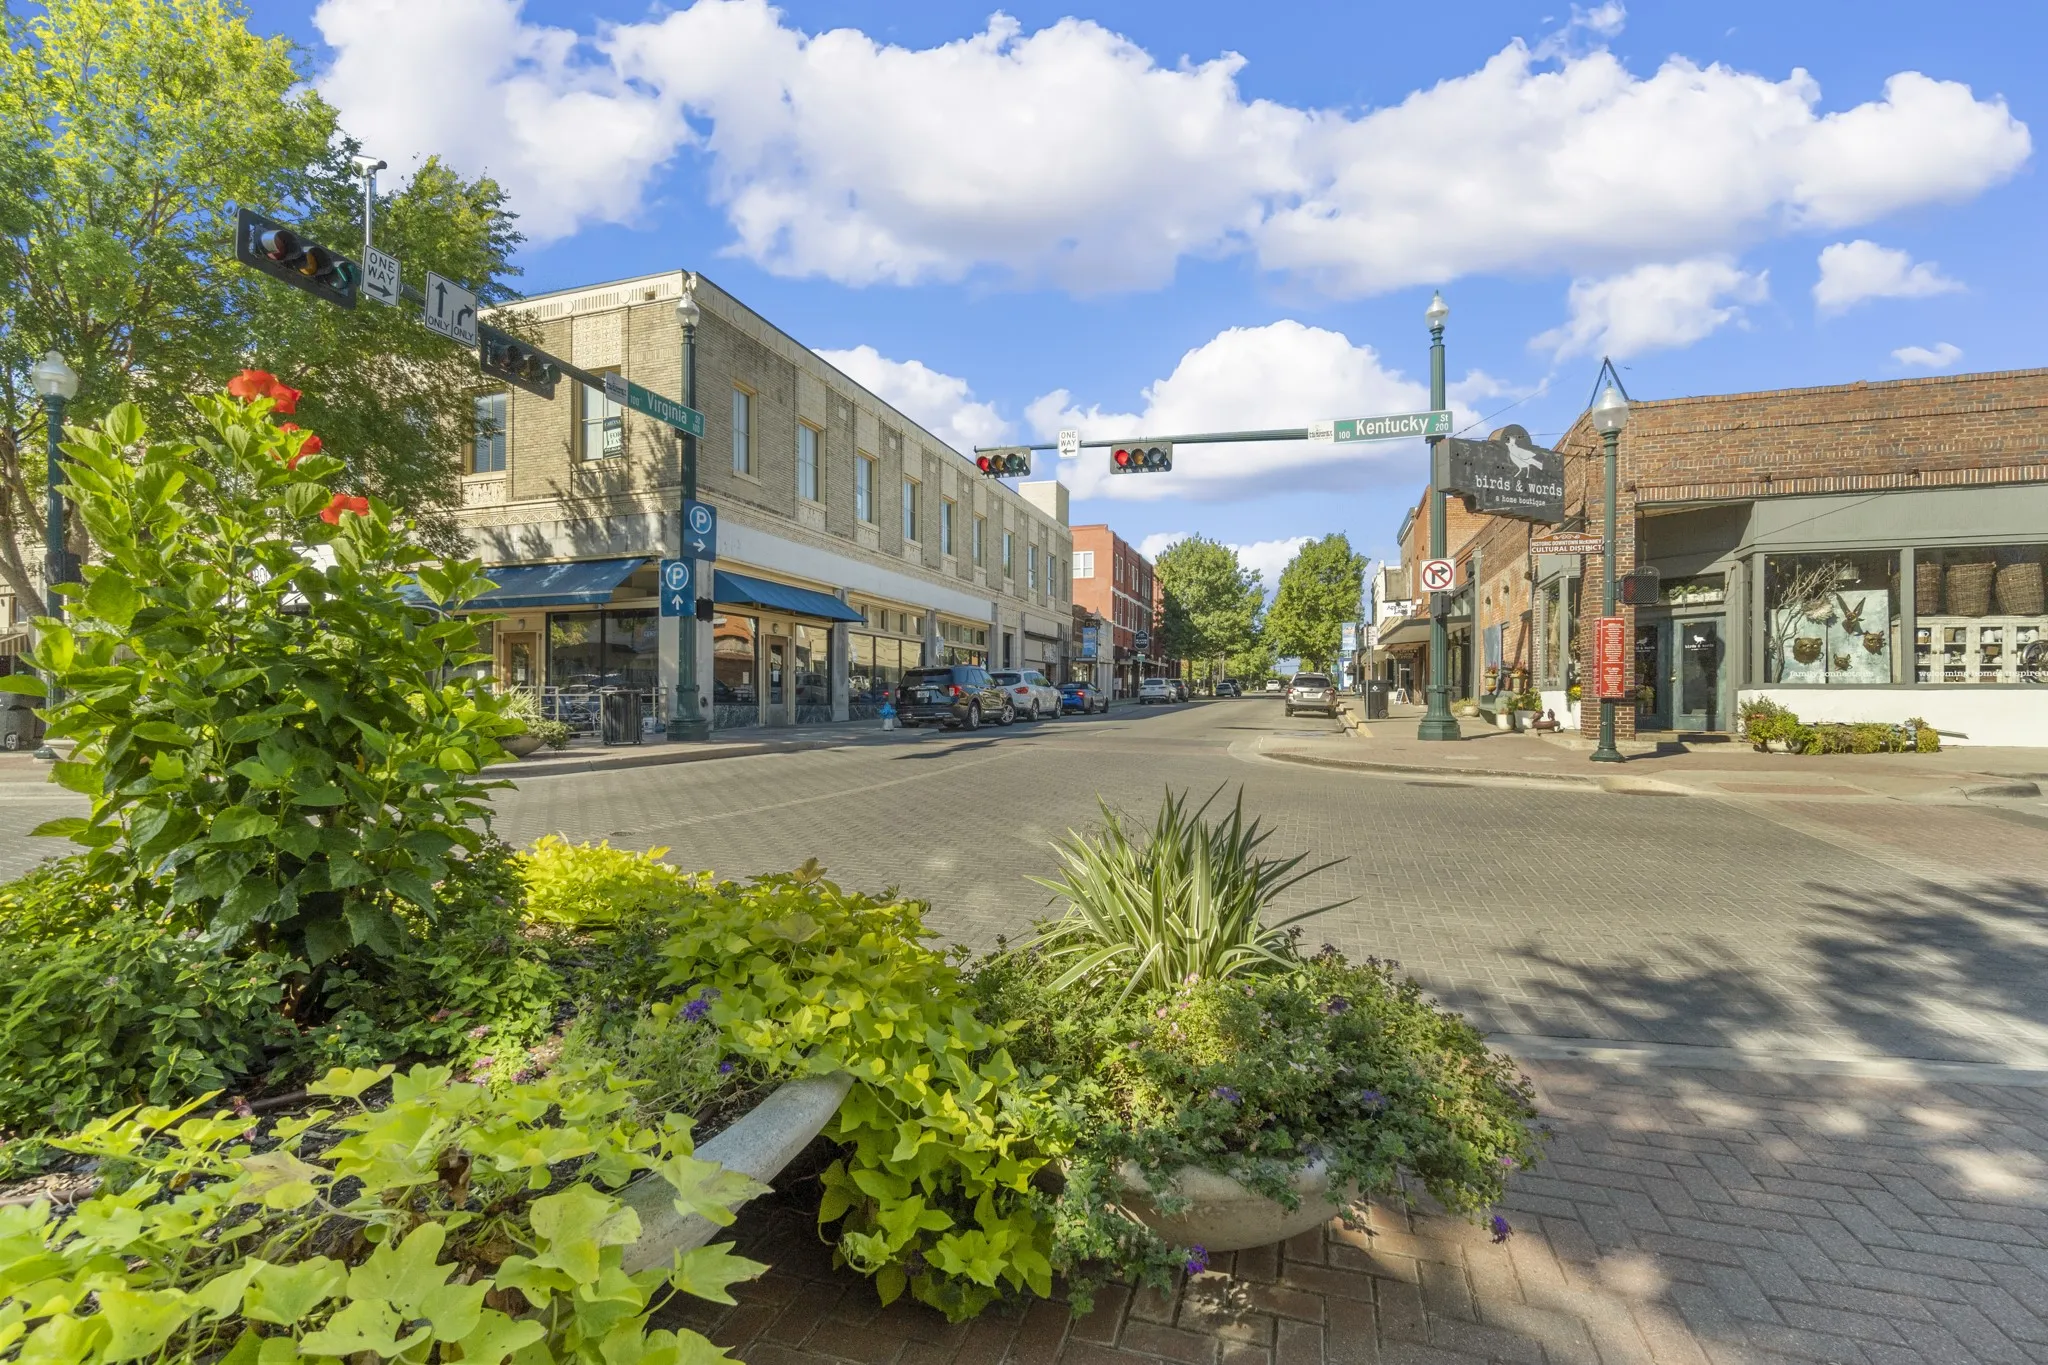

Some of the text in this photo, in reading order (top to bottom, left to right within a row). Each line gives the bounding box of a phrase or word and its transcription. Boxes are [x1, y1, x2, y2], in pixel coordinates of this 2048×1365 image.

[370, 253, 395, 273] ONE
[368, 265, 394, 285] WAY
[428, 316, 474, 340] ONLY ONLY
[630, 395, 640, 406] 100
[647, 391, 687, 424] Virginia
[1060, 431, 1076, 439] ONE
[1339, 431, 1351, 439] 100
[1356, 416, 1429, 437] Kentucky
[1440, 414, 1449, 422] St
[1435, 423, 1449, 432] 200
[1475, 475, 1563, 496] birds & words
[1501, 495, 1517, 504] home
[1518, 497, 1546, 507] boutique
